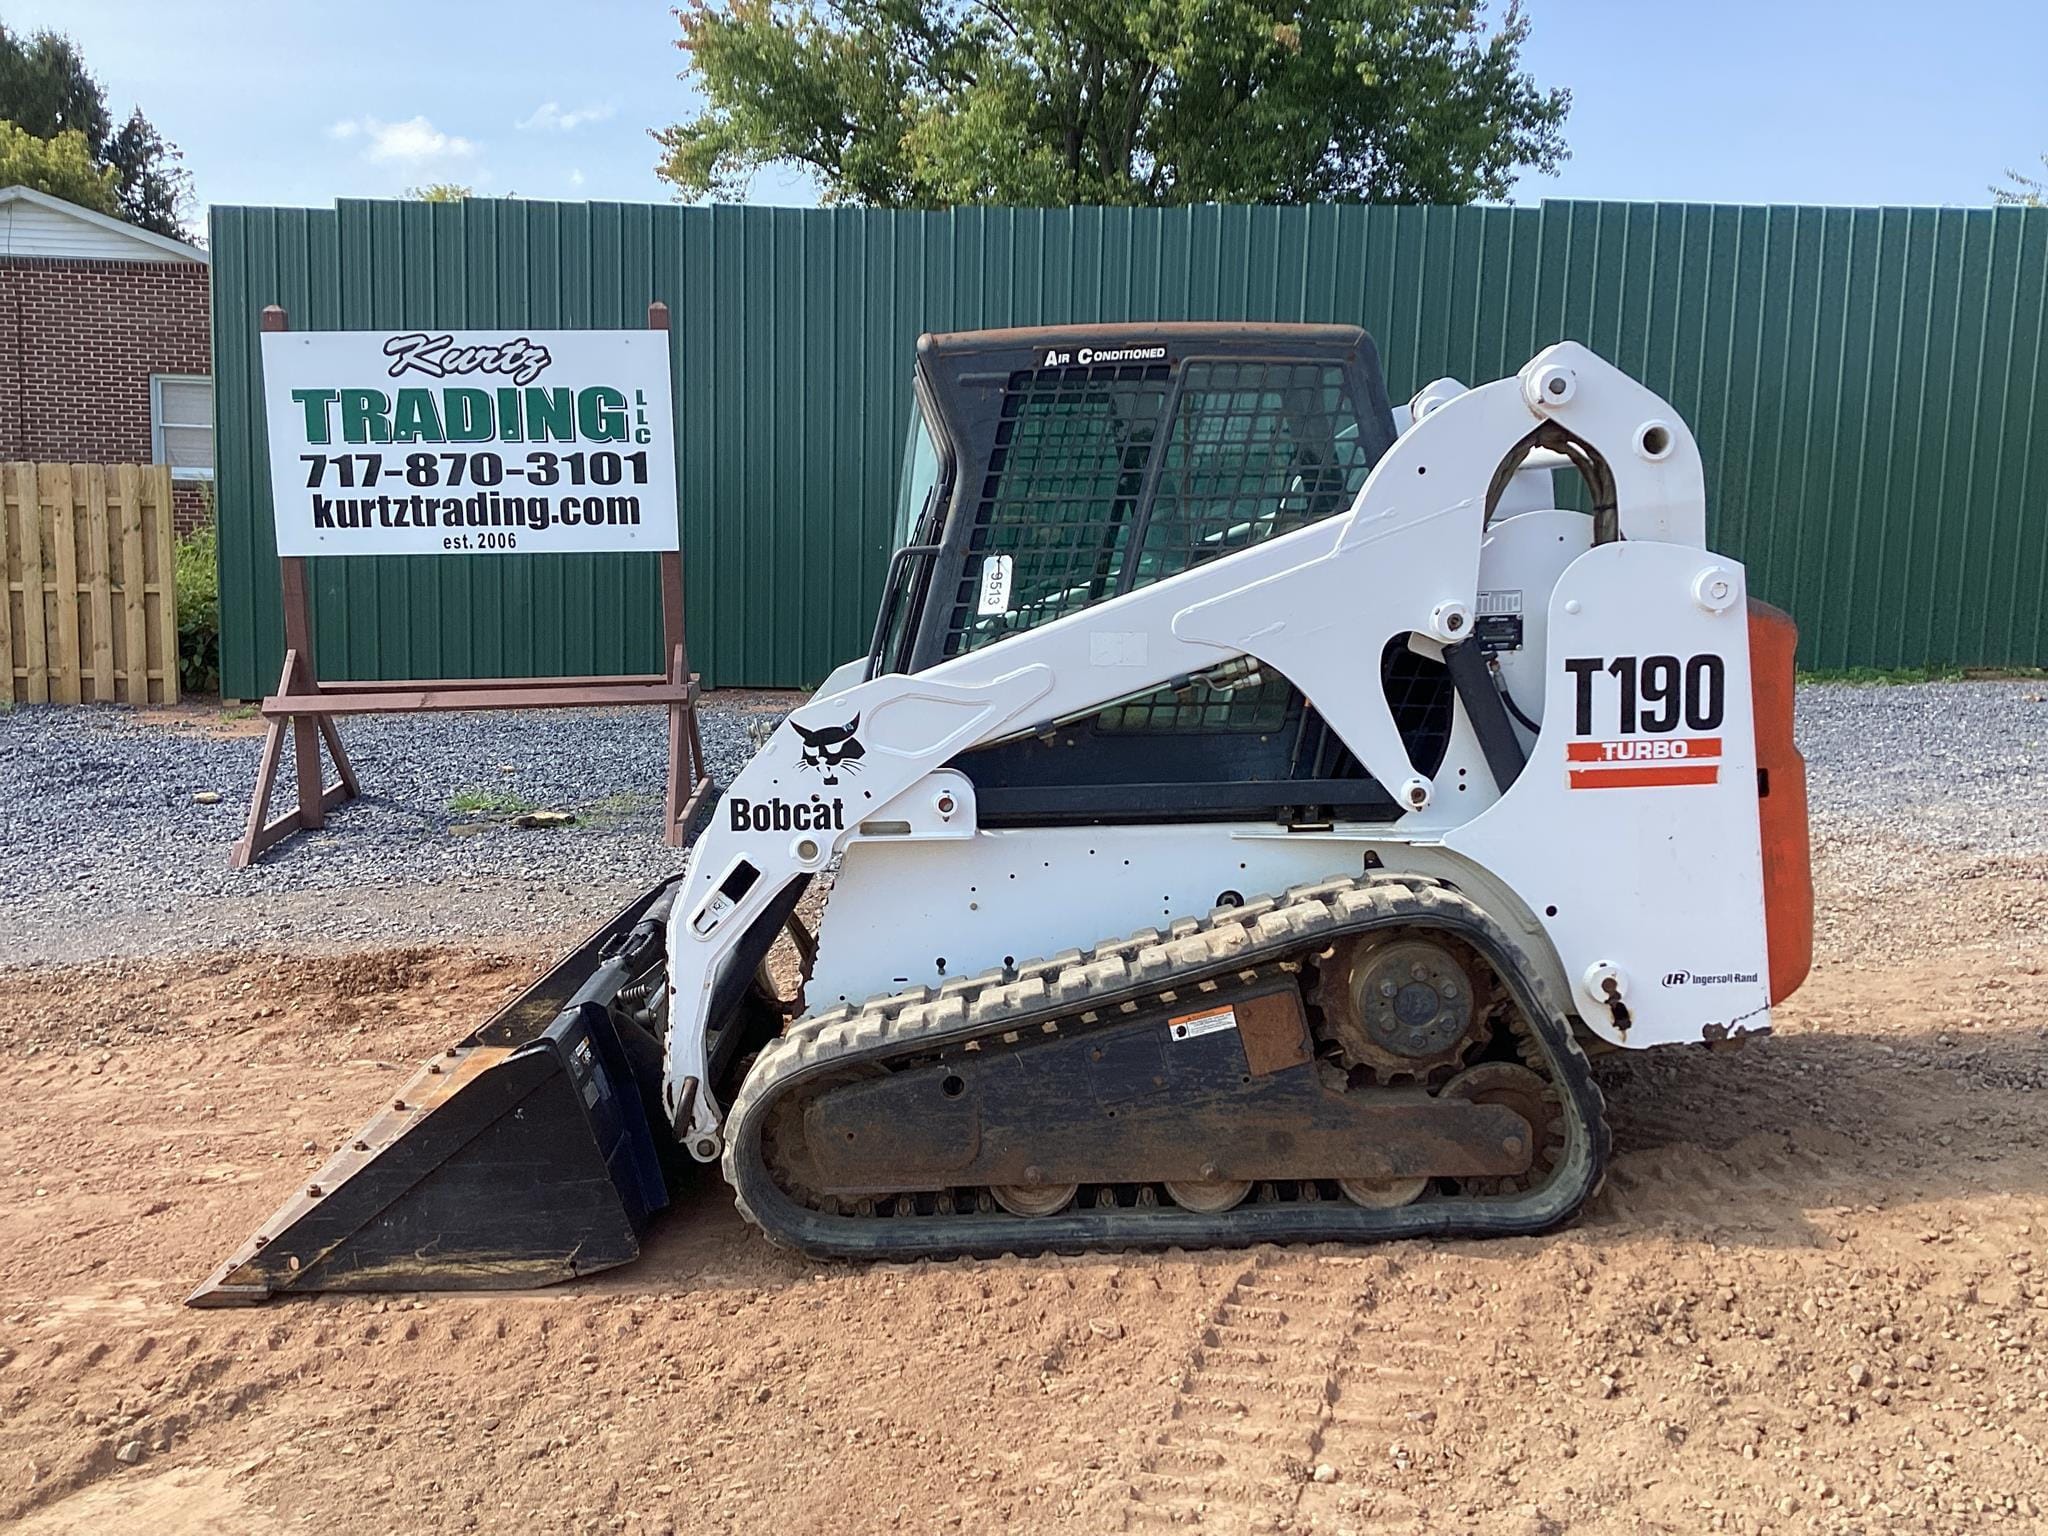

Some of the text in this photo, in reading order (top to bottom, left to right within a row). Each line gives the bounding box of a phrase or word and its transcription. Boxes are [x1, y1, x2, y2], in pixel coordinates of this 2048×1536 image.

[383, 333, 552, 386] Kurtz
[292, 386, 631, 445] TRADING
[635, 389, 652, 444] LLC
[300, 450, 649, 488] 717-870-3101
[312, 491, 641, 531] kurtztrading.com
[443, 532, 517, 550] est. 2006
[987, 572, 1004, 606] 9513
[1565, 654, 1725, 736] T190
[1602, 740, 1688, 760] TURBO
[730, 798, 844, 831] Bobcat
